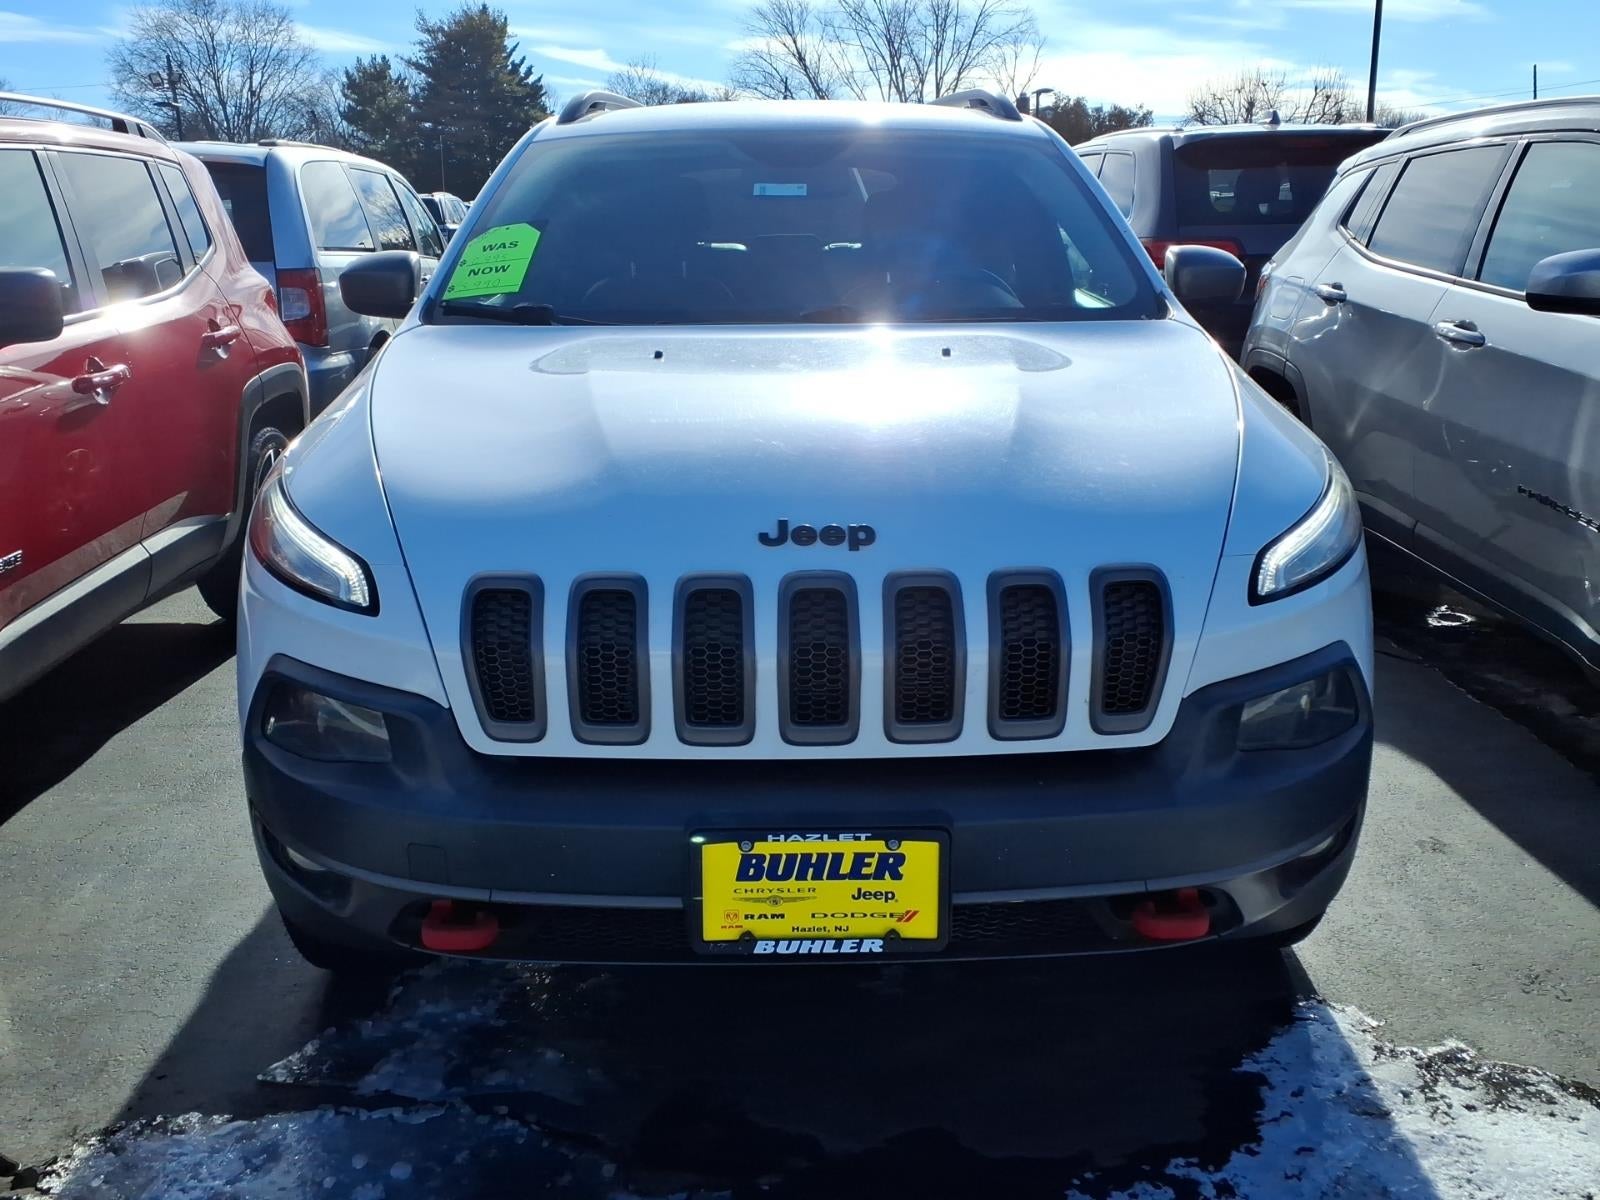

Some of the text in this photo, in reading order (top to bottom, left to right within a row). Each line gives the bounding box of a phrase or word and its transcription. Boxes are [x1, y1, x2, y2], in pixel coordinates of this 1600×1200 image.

[482, 240, 519, 252] WAS
[467, 264, 510, 277] NOW
[758, 517, 877, 552] Jeep
[767, 833, 872, 842] HAZLET
[735, 852, 906, 882] BUHLER
[851, 887, 896, 904] Jeep
[791, 925, 849, 934] Hazlet, NJ
[753, 939, 884, 954] BUHLER
